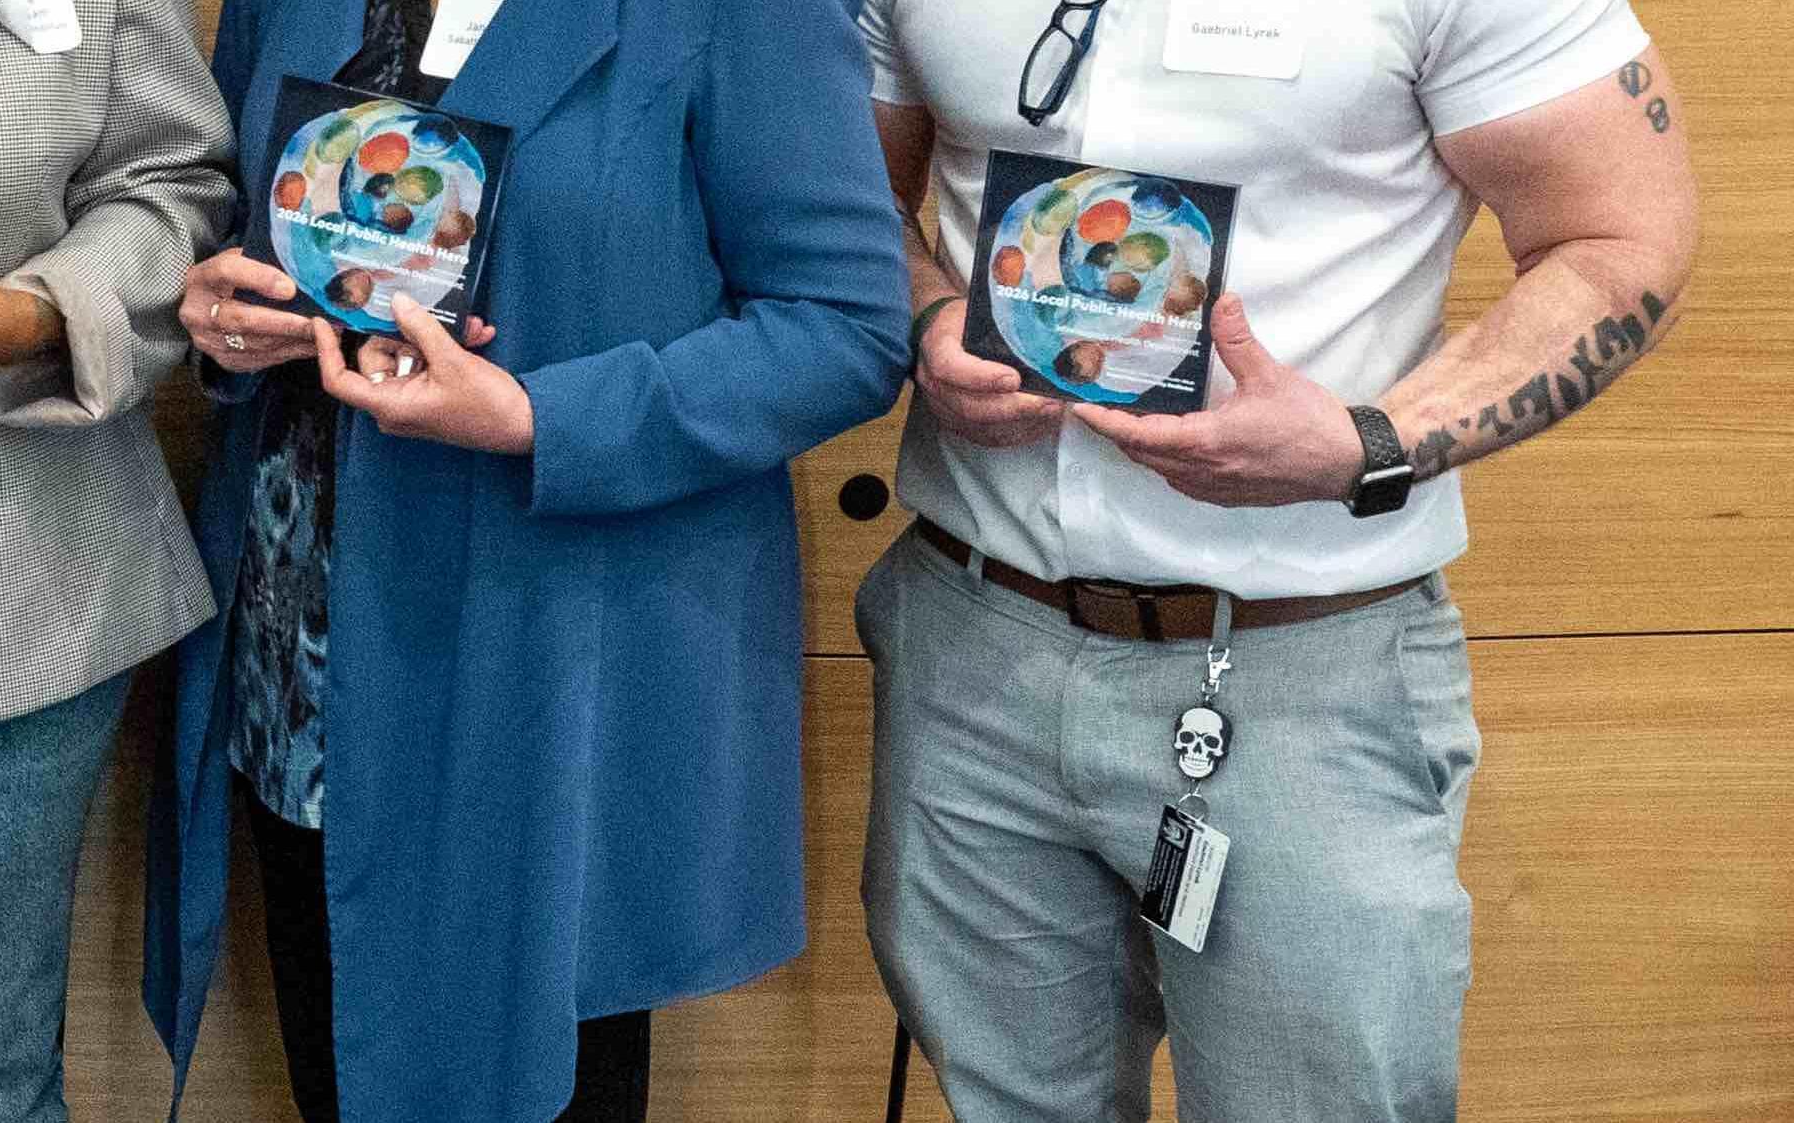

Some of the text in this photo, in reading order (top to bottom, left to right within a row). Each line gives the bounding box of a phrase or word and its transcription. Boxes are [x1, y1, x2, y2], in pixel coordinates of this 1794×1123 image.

[311, 215, 345, 234] Local
[347, 223, 387, 245] Public
[389, 235, 435, 257] Health
[436, 246, 470, 265] Hero
[1032, 290, 1070, 309] Local
[1071, 296, 1116, 316] Public
[1117, 306, 1165, 325] Health
[1168, 315, 1202, 331] Hero
